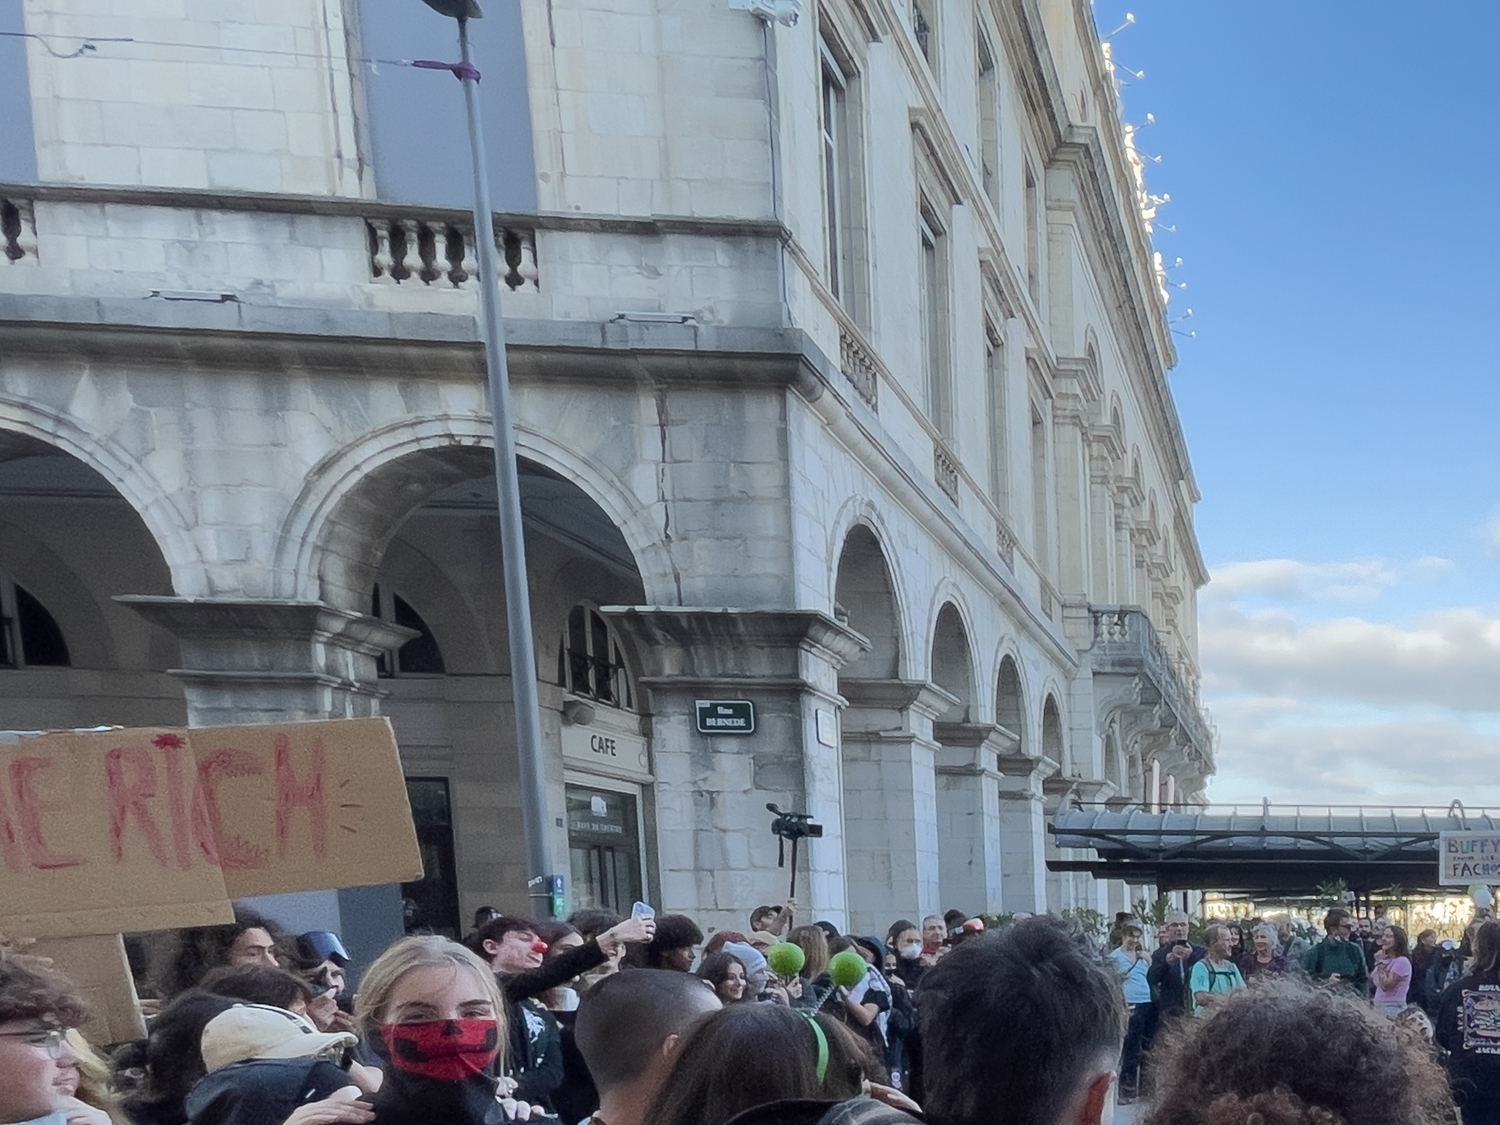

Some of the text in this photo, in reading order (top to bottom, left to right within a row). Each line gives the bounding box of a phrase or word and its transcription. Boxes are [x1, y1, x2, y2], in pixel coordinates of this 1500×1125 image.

[717, 706, 733, 714] Rue
[590, 735, 617, 757] CAFE
[1448, 839, 1500, 854] BUFFY
